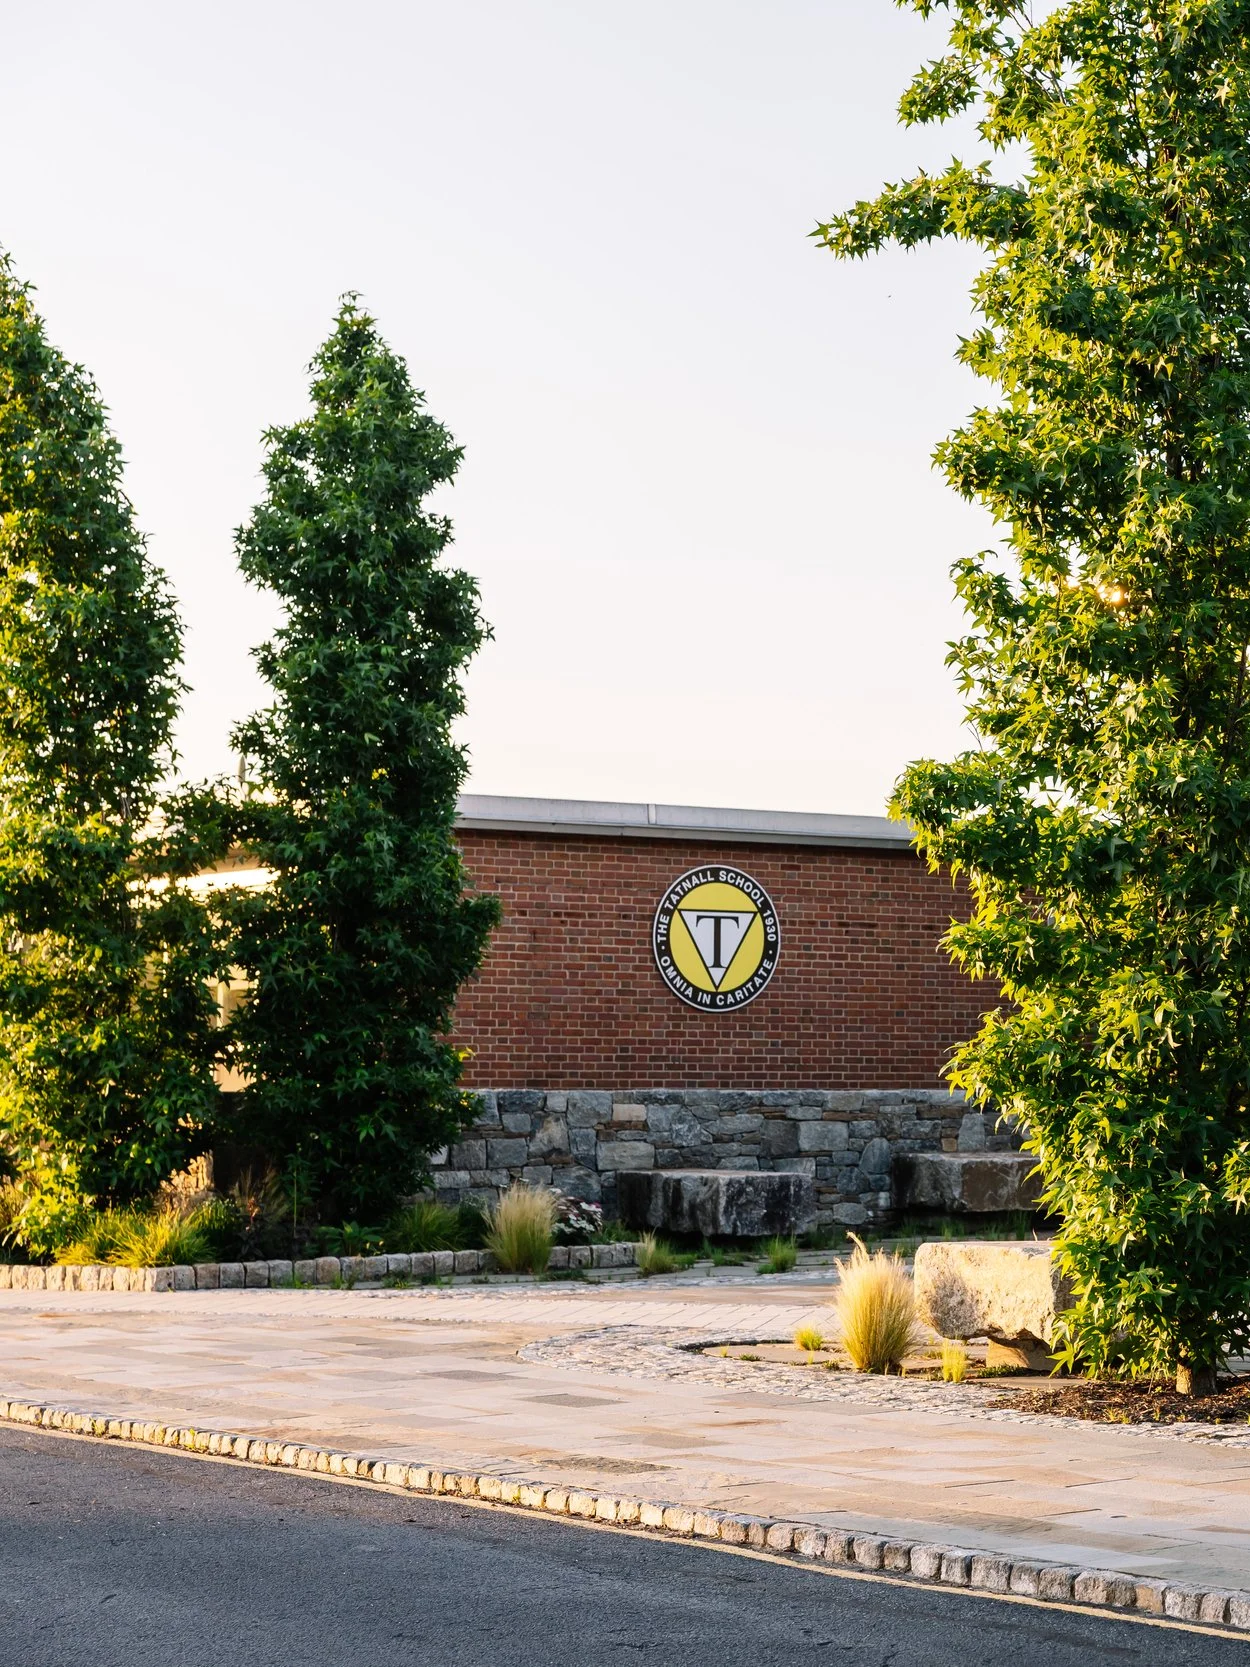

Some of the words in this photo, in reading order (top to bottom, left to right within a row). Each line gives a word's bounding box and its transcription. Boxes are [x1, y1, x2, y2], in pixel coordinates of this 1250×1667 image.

[657, 914, 670, 943] THE
[664, 870, 715, 910] TATNALL
[718, 870, 765, 907] SCHOOL
[762, 909, 777, 942] 1930
[695, 914, 740, 968] T
[660, 956, 693, 998] OMNIA
[697, 992, 711, 1005] IN
[716, 958, 774, 1006] CARITATE
